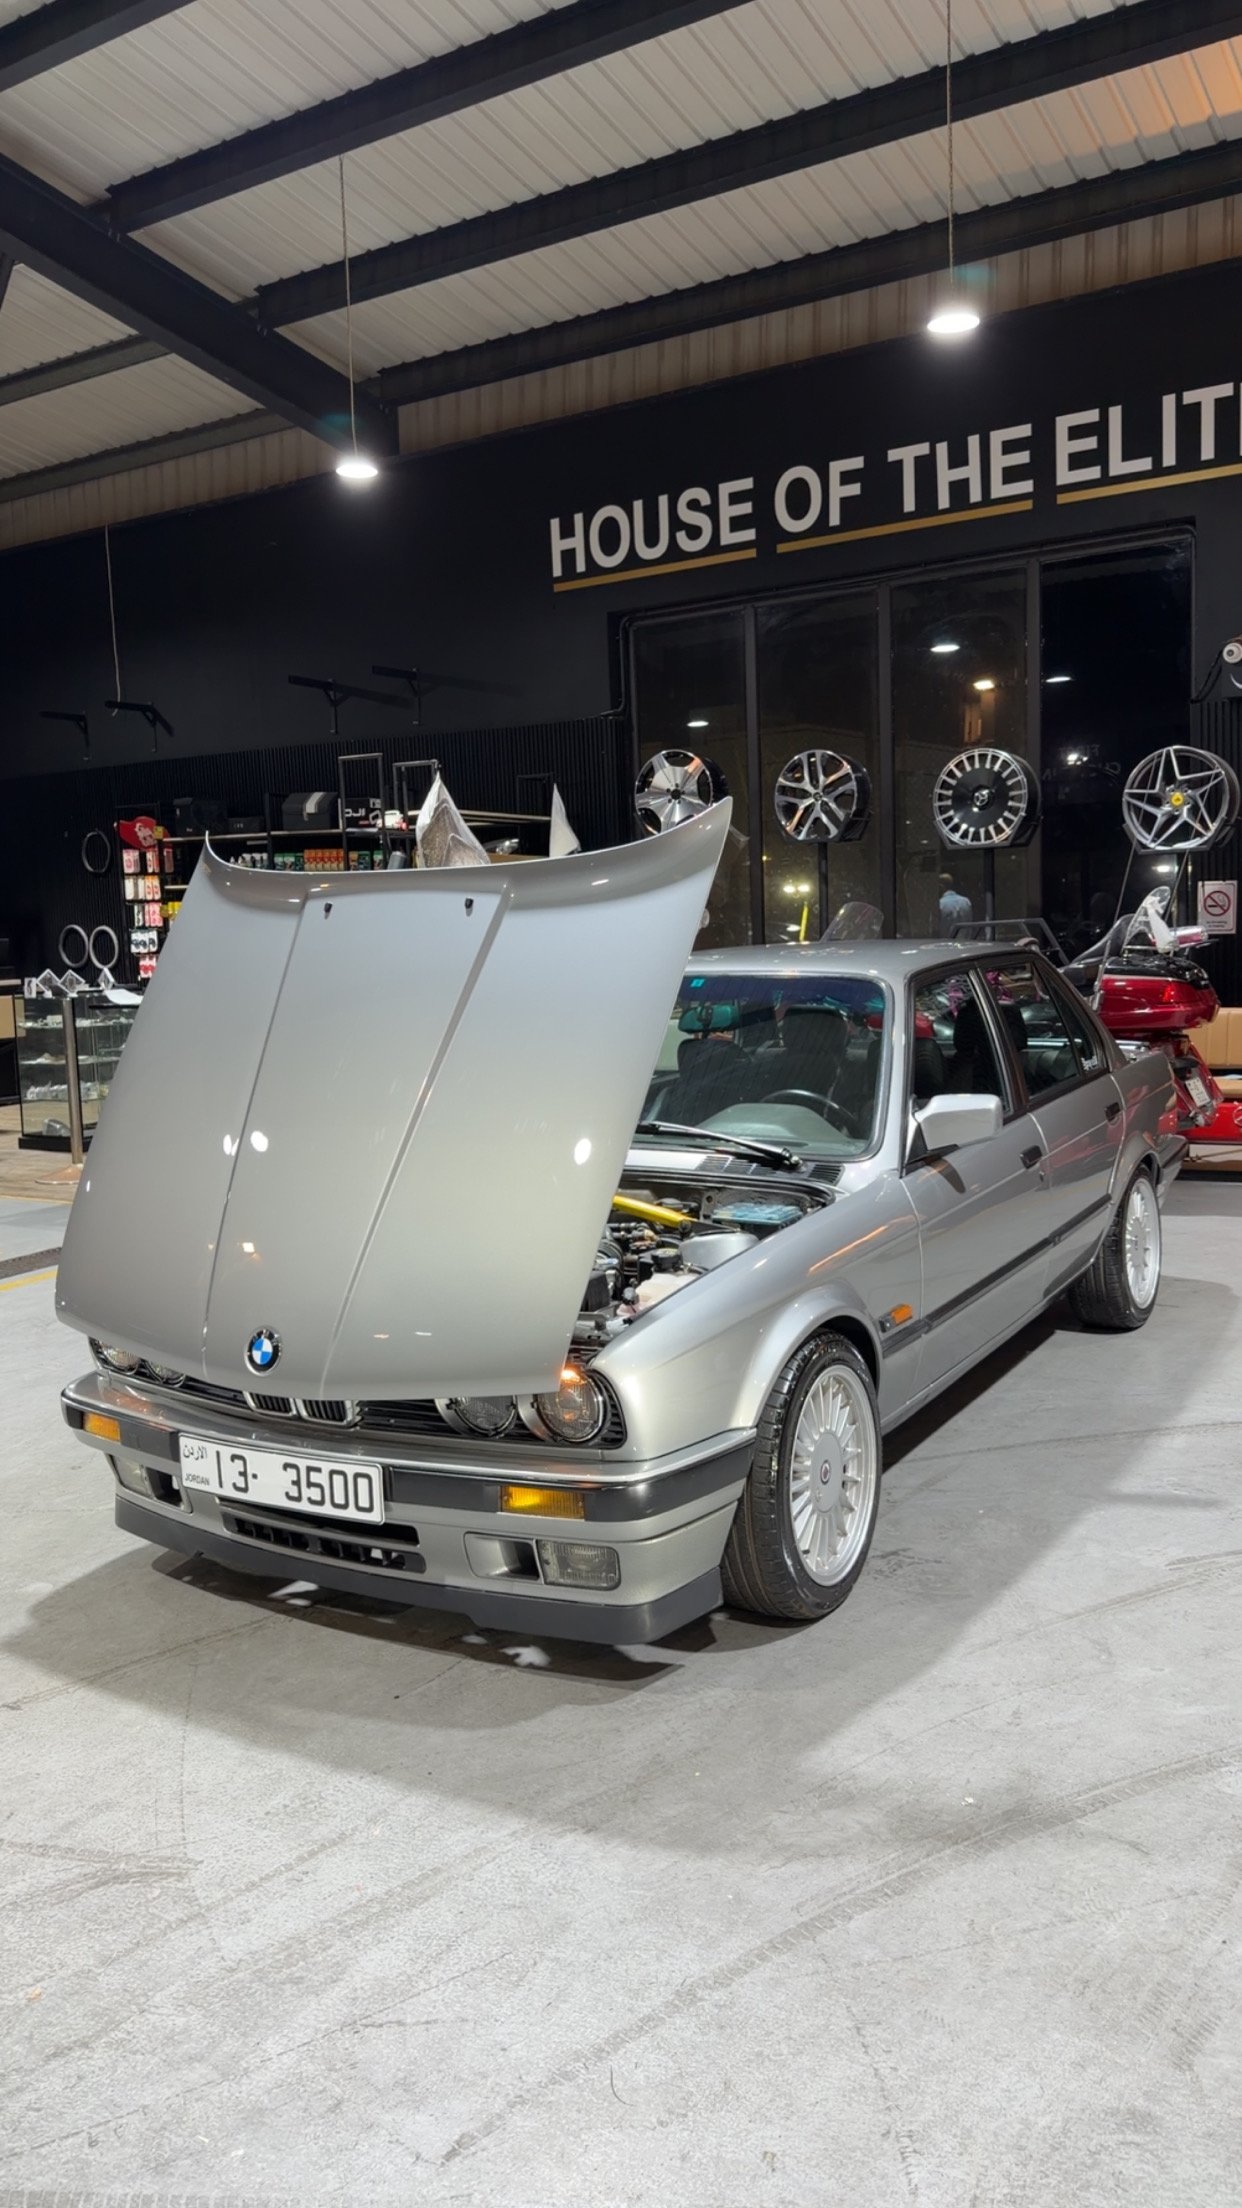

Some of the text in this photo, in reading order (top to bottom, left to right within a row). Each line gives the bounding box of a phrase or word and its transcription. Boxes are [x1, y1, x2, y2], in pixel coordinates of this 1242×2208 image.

[550, 382, 1242, 577] HOUSE OF THE ELIT
[185, 1473, 210, 1486] JORDAN
[283, 1462, 374, 1513] 3500
